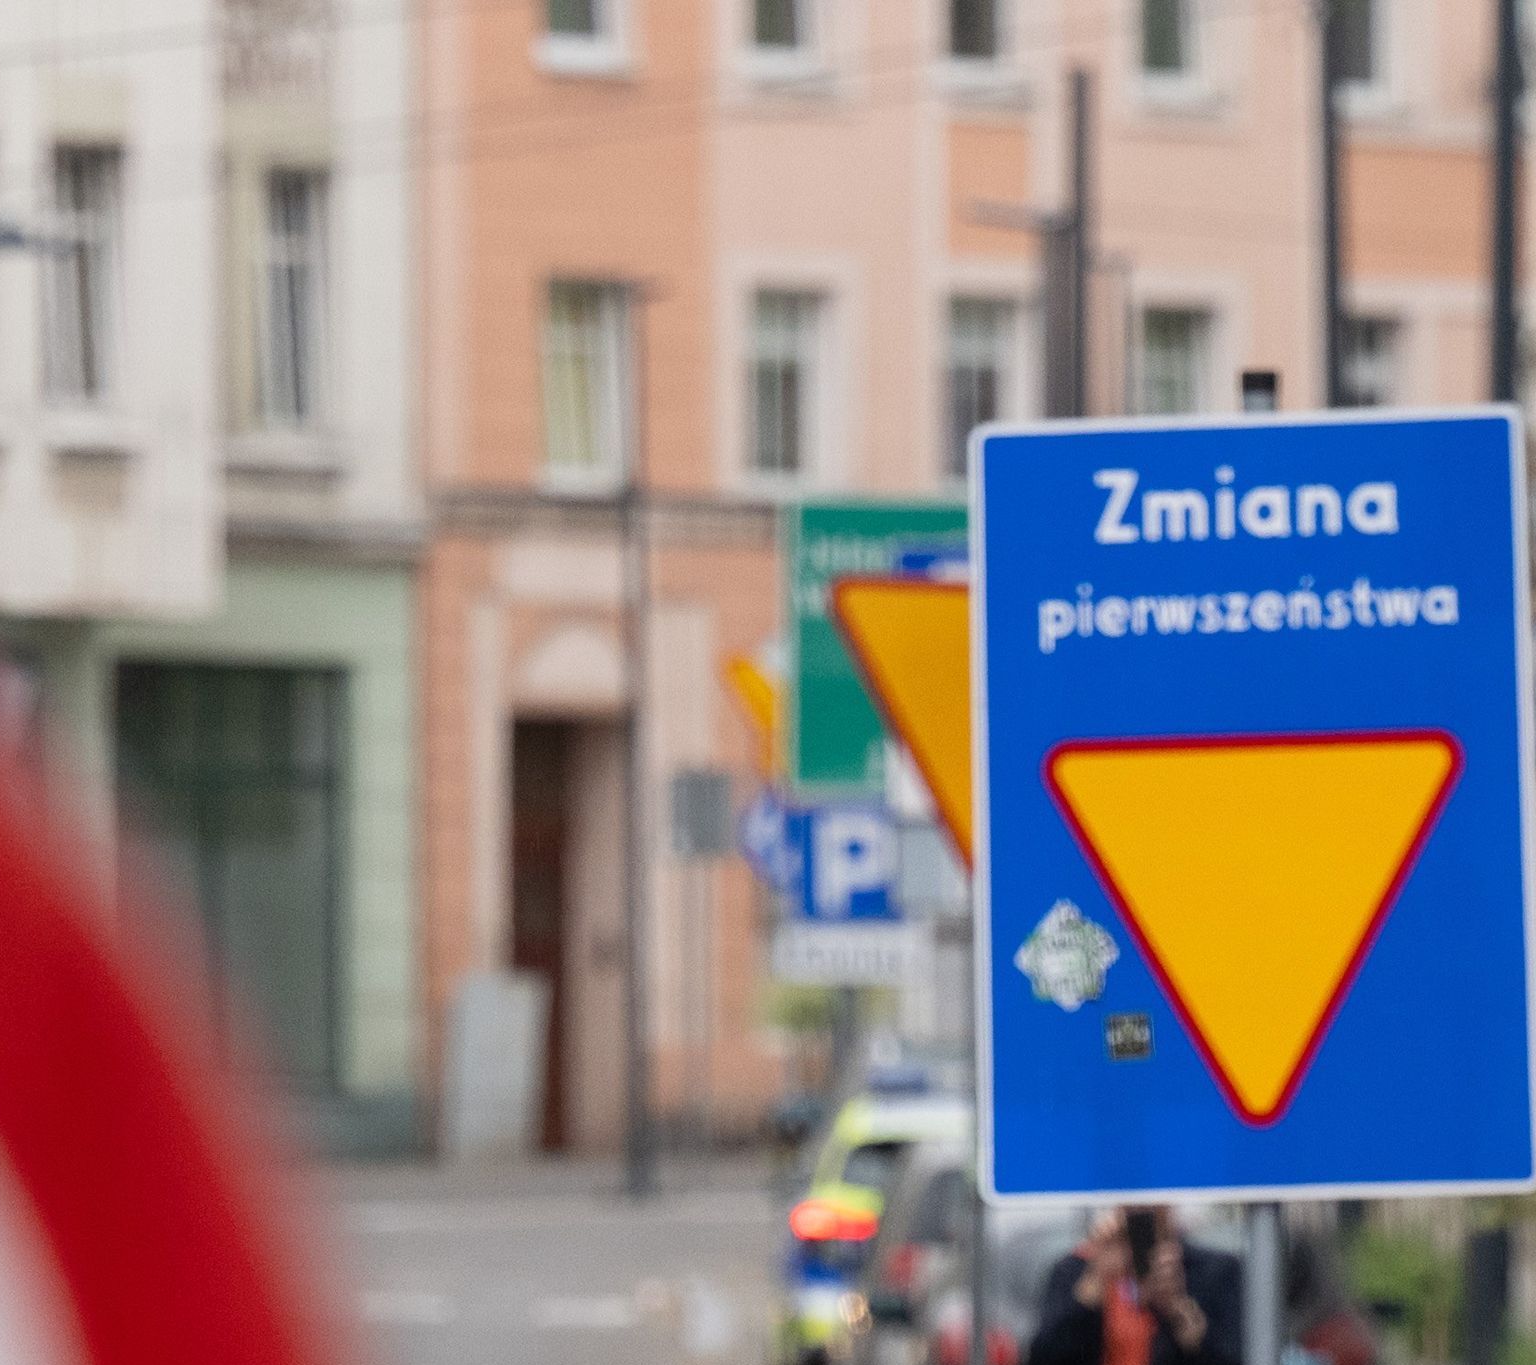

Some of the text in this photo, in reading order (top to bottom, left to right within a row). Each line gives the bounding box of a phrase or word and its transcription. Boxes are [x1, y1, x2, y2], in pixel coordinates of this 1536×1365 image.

[1093, 463, 1399, 544] Zmiana
[1037, 574, 1460, 655] pierwszeństwa
[814, 812, 894, 916] P
